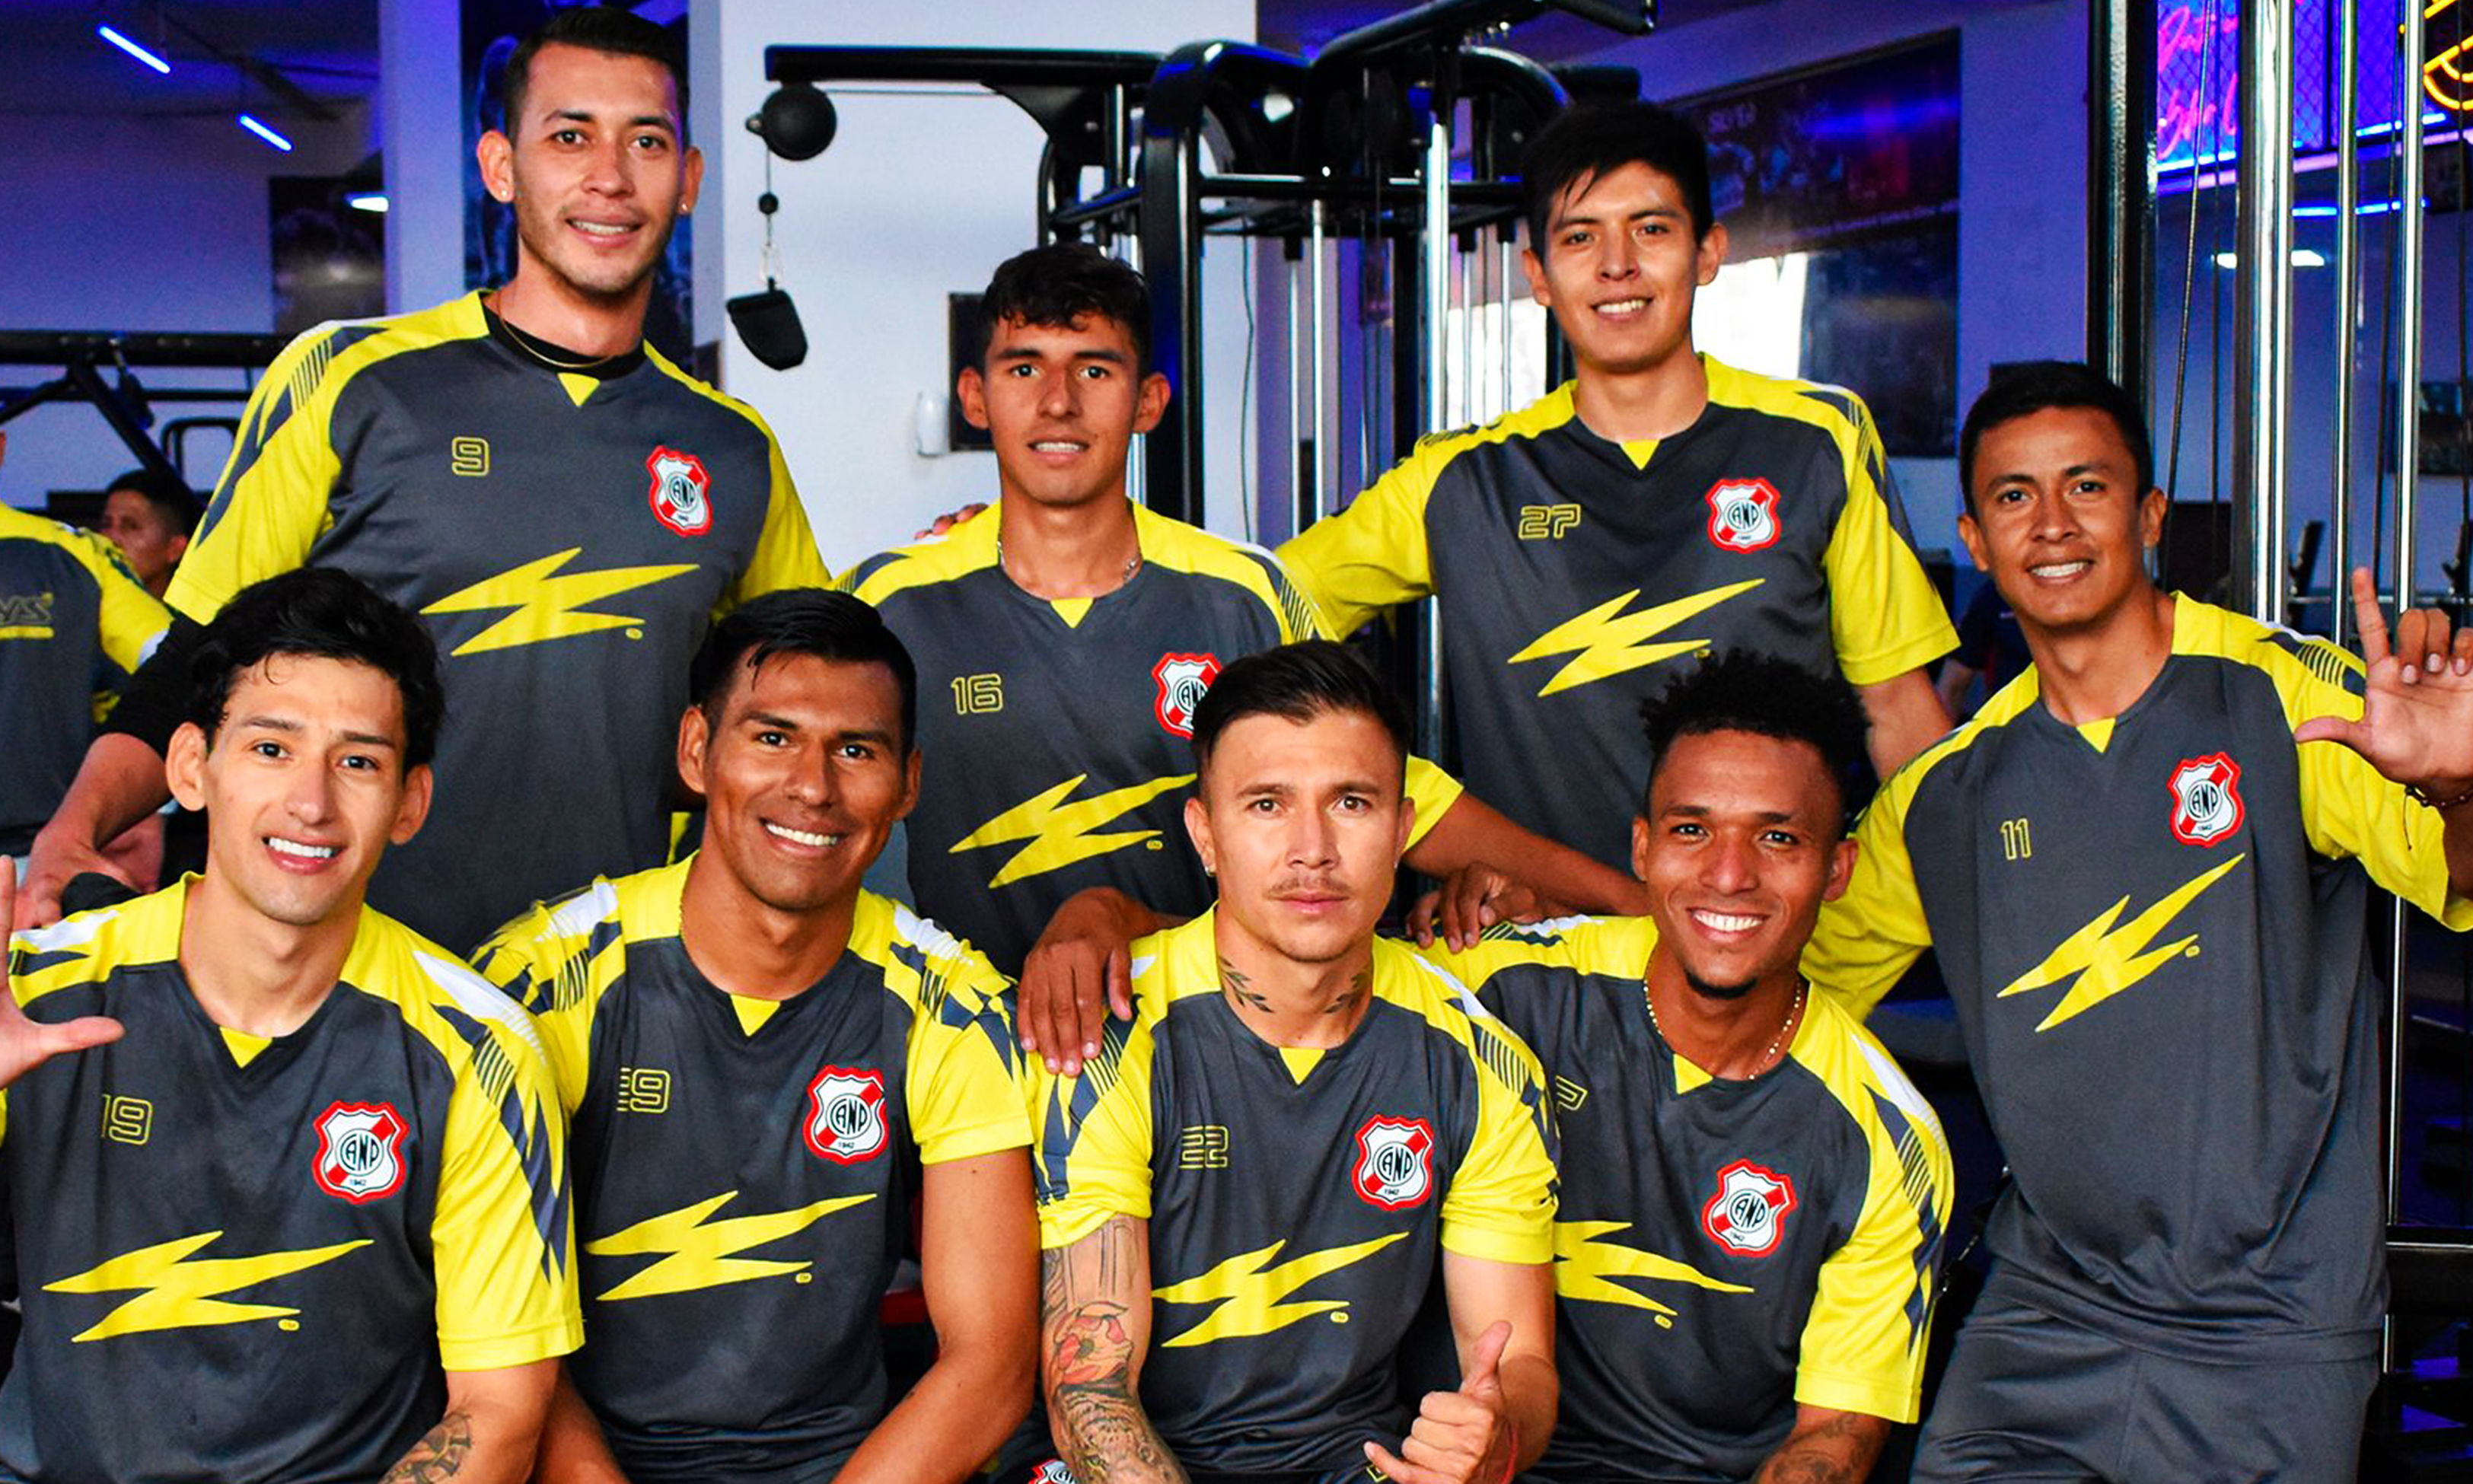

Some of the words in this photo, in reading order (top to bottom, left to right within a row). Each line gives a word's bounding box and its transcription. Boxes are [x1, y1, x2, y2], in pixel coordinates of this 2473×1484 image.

[451, 435, 490, 477] 9
[1518, 503, 1582, 540] 27
[950, 673, 1004, 715] 16
[2000, 818, 2032, 861] 11
[1178, 1125, 1229, 1169] 22
